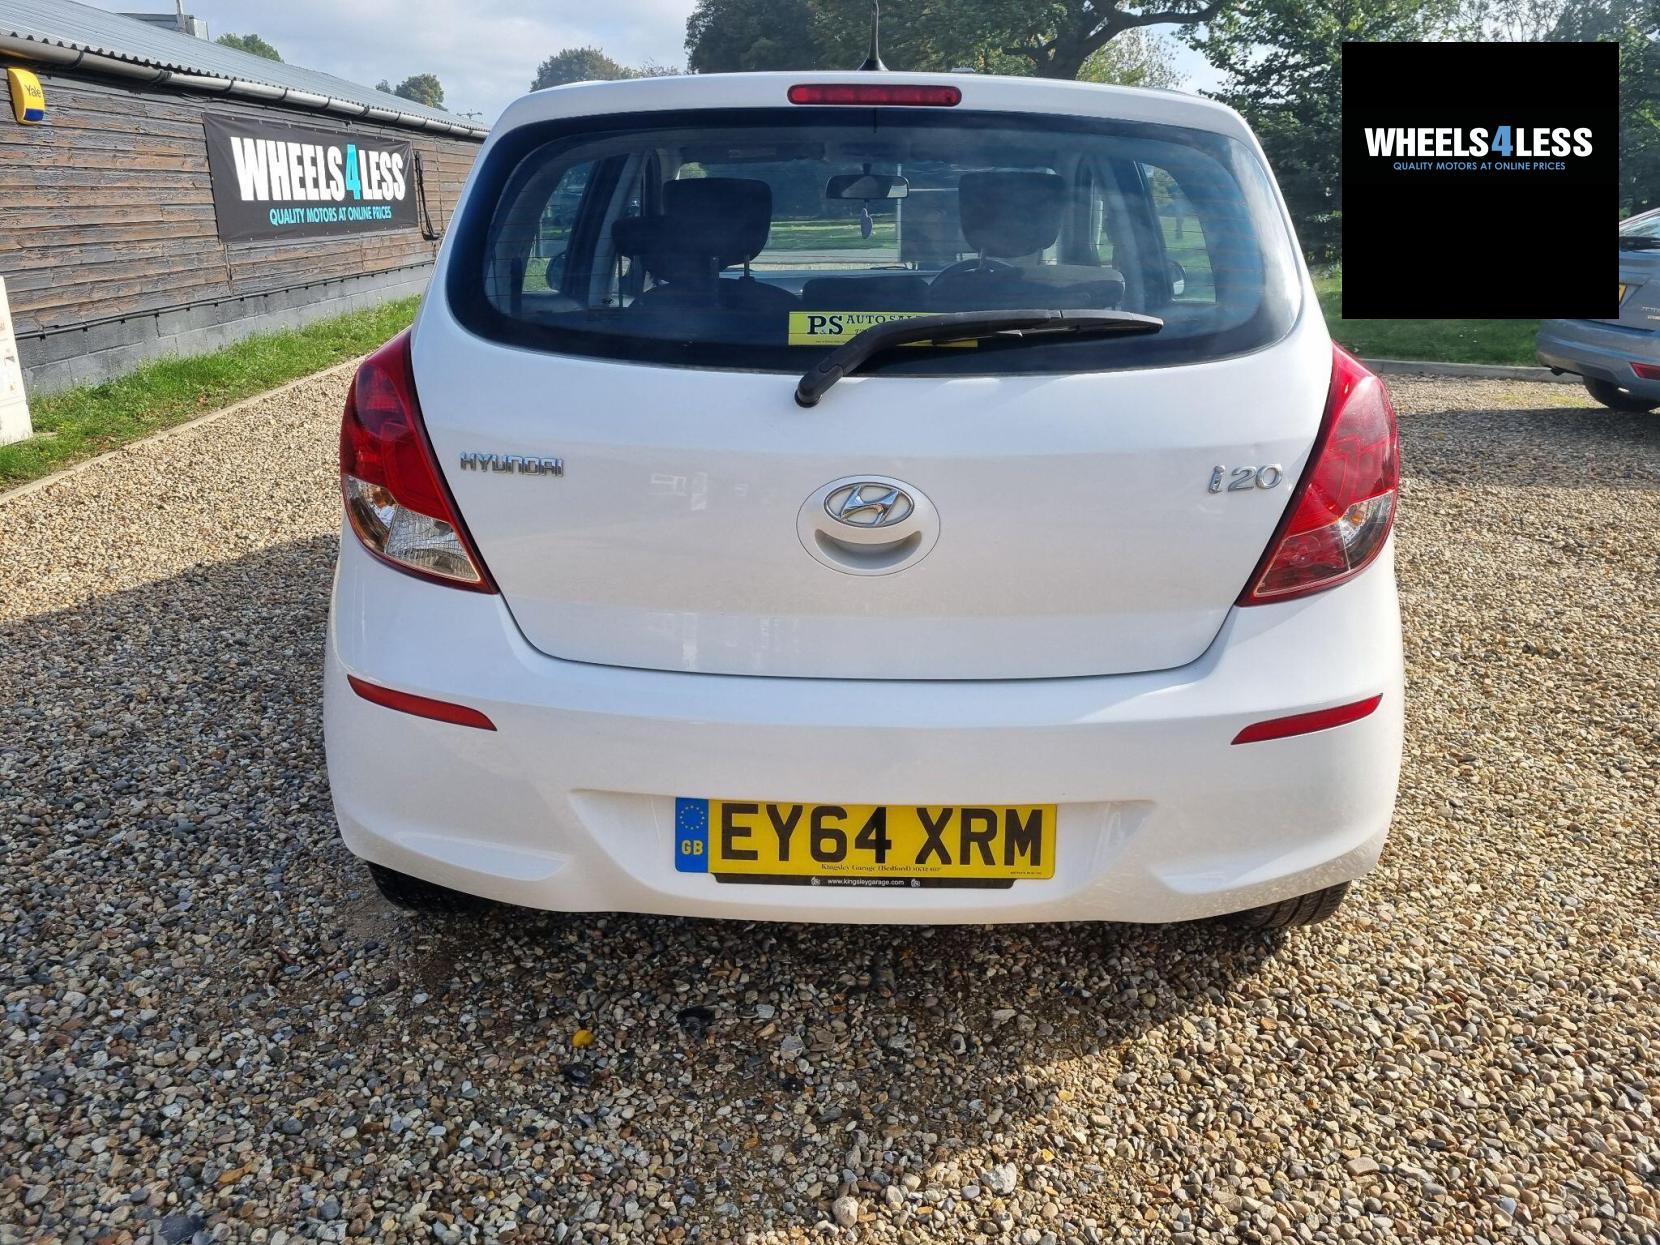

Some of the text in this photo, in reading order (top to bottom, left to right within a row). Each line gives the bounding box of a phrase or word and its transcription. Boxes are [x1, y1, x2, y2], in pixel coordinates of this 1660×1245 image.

[24, 84, 41, 97] Yale
[230, 137, 406, 201] WHEELS4LESS
[269, 205, 392, 226] QUALITY MOTORS AT ONLINE PRICES
[846, 315, 886, 324] AUTO
[460, 452, 564, 477] HYUNDAI
[721, 802, 1043, 866] EY64 XRM
[681, 840, 703, 856] GB
[821, 863, 850, 872] Kingsley
